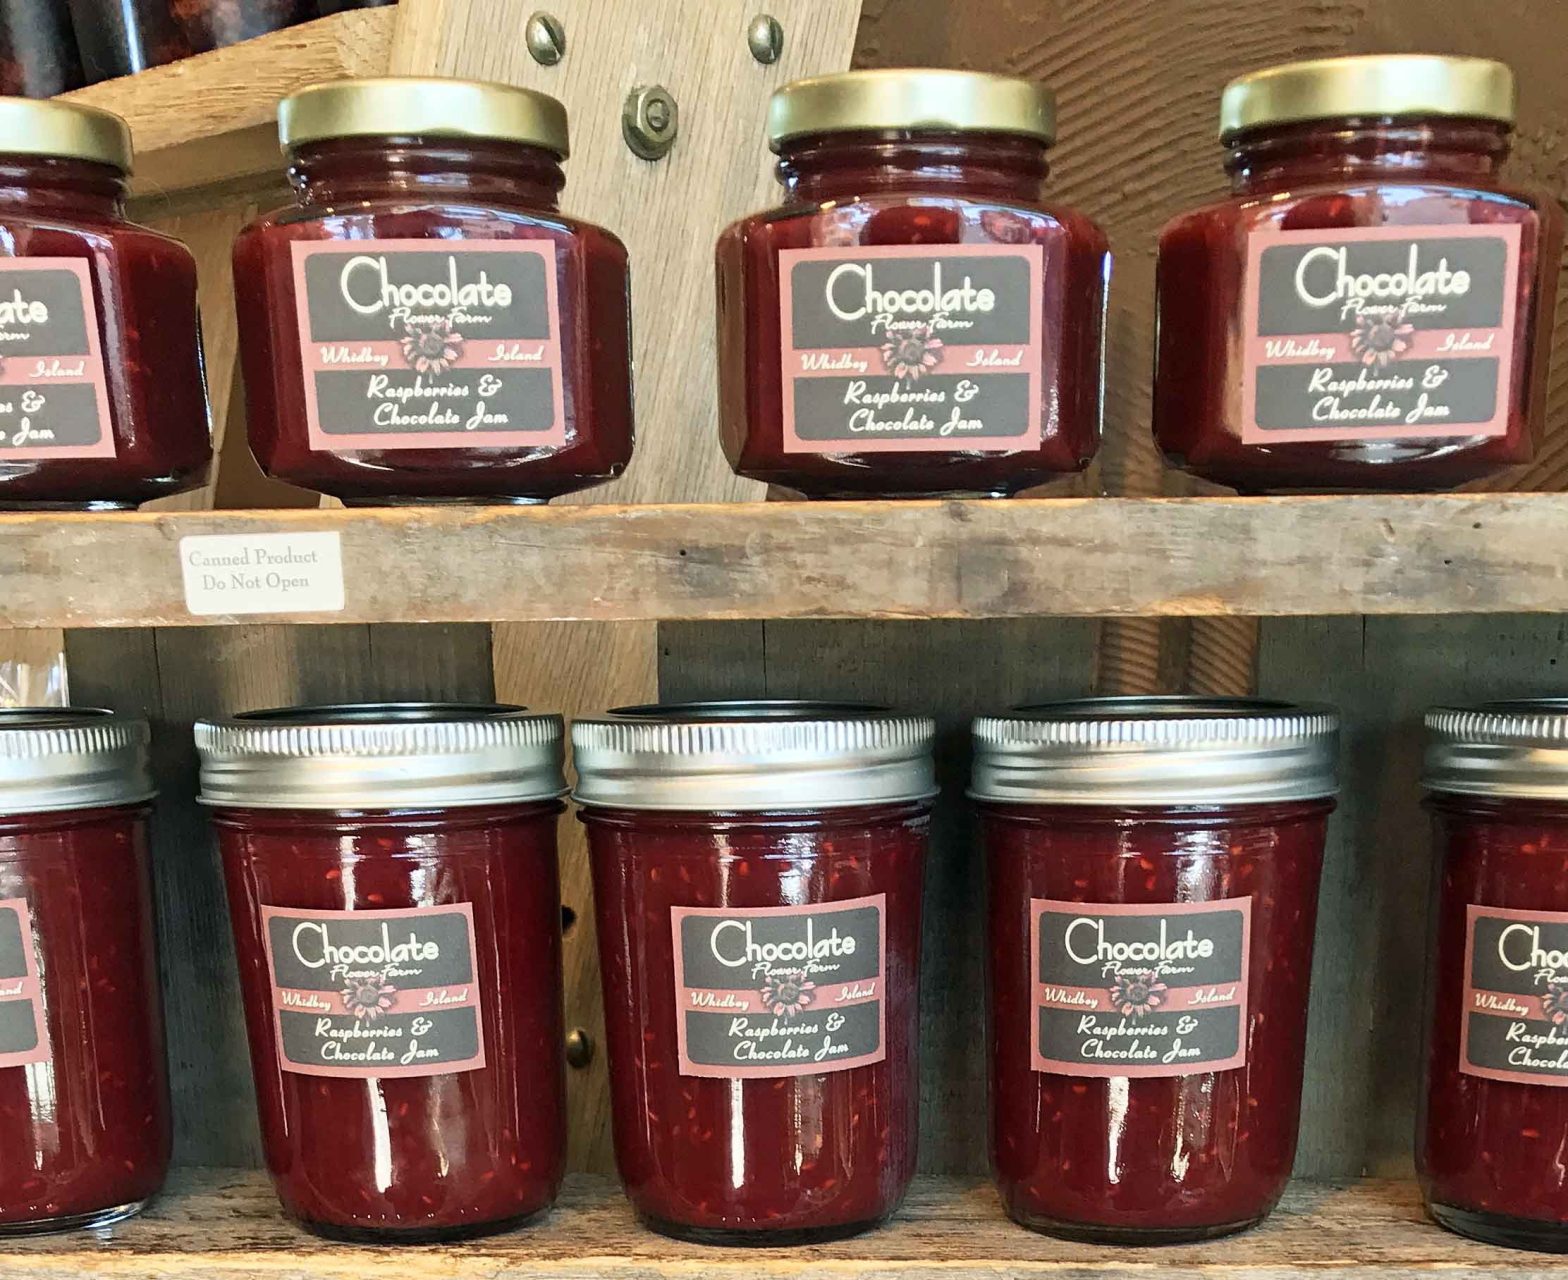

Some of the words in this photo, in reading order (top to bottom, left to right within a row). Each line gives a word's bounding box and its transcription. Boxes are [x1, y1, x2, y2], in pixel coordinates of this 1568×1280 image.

[341, 256, 512, 313] Chocolate
[1296, 243, 1470, 307] Chocolate
[826, 262, 995, 320] Chocolate
[389, 308, 444, 328] Flower
[447, 307, 492, 327] Farm
[1341, 298, 1398, 321] Flower
[1400, 295, 1446, 317] Farm
[871, 312, 927, 334] Flower
[928, 312, 973, 331] Farm
[320, 347, 389, 366] Whidbey
[488, 344, 544, 361] Island
[1265, 340, 1335, 359] Whidbey
[1437, 333, 1494, 351] Island
[30, 361, 84, 378] Island
[801, 354, 868, 372] Whidbey
[966, 350, 1023, 367] Island
[367, 375, 469, 403] Raspberries
[478, 374, 502, 396] &
[1308, 368, 1413, 396] Raspberries
[1422, 365, 1448, 388] &
[21, 391, 45, 412] &
[844, 381, 945, 409] Raspberries
[954, 380, 979, 401] &
[374, 402, 460, 425] Chocolate
[466, 401, 508, 430] Jam
[1312, 395, 1401, 421] Chocolate
[1406, 393, 1449, 423] Jam
[12, 416, 55, 446] Jam
[849, 407, 934, 432] Chocolate
[940, 406, 983, 436] Jam
[189, 547, 249, 566] Canned
[254, 546, 318, 565] Product
[203, 575, 226, 590] Do
[231, 573, 261, 589] Not
[266, 572, 309, 592] Open
[293, 922, 439, 968] Chocolate
[711, 918, 855, 967] Chocolate
[1065, 918, 1214, 964] Chocolate
[330, 964, 379, 981] Flower
[380, 963, 422, 980] Farm
[751, 962, 801, 979] Flower
[803, 959, 840, 977] Farm
[1102, 962, 1152, 978] Flower
[1153, 960, 1194, 978] Farm
[282, 992, 331, 1010] Whidbey
[419, 989, 468, 1006] Island
[691, 992, 749, 1010] Whidbey
[835, 983, 875, 1001] Island
[1045, 988, 1098, 1008] Whidbey
[1188, 987, 1235, 1004] Island
[1475, 993, 1529, 1016] Whidbey
[315, 1018, 402, 1042] Raspberries
[411, 1017, 433, 1035] &
[728, 1018, 818, 1041] Raspberries
[826, 1013, 845, 1031] &
[1077, 1015, 1168, 1040] Raspberries
[1176, 1016, 1198, 1035] &
[321, 1041, 395, 1060] Chocolate
[401, 1040, 439, 1064] Jam
[734, 1040, 809, 1059] Chocolate
[815, 1036, 848, 1061] Jam
[1081, 1039, 1157, 1059] Chocolate
[1162, 1038, 1200, 1063] Jam
